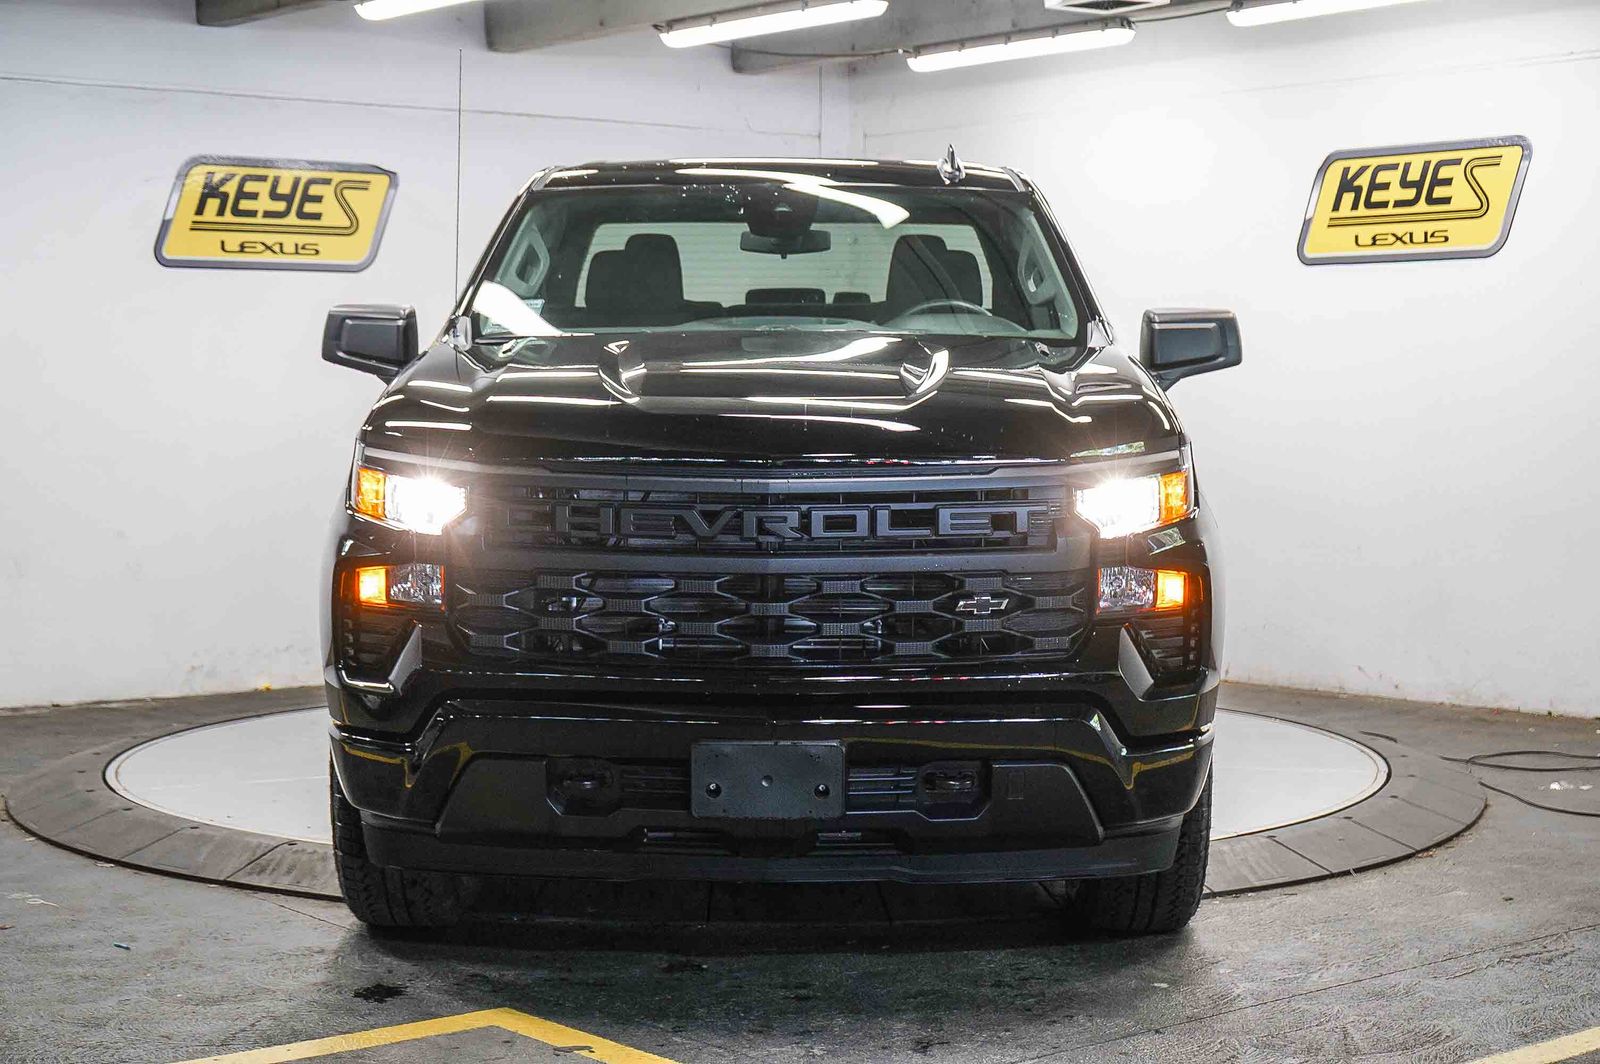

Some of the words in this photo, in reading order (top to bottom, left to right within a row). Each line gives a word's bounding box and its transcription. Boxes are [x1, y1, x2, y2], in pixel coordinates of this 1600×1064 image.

[190, 171, 371, 236] KEYES
[1327, 155, 1503, 228] KEYES
[220, 240, 320, 256] LEXUS
[1354, 229, 1450, 247] LEXUS
